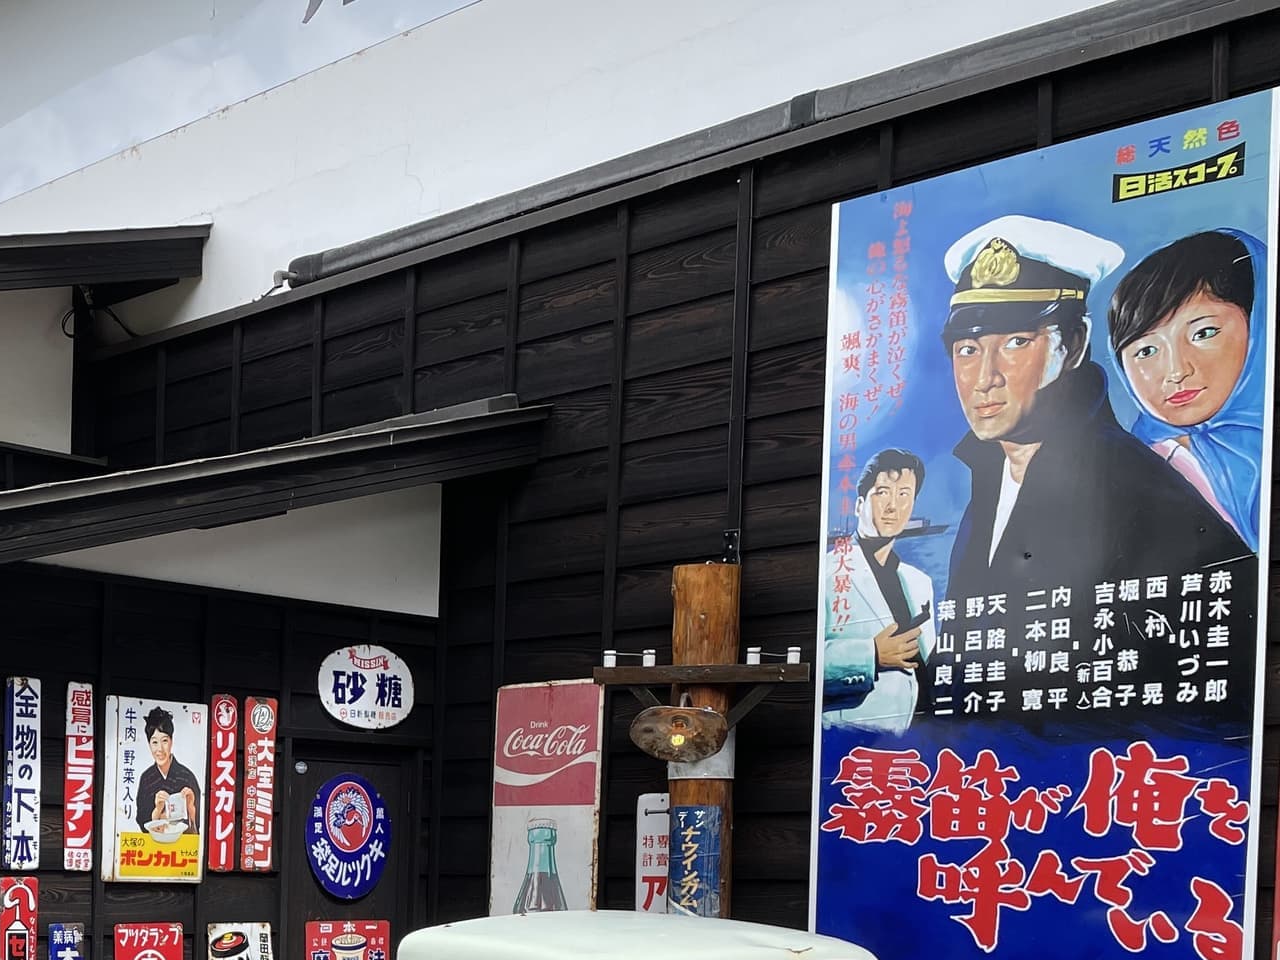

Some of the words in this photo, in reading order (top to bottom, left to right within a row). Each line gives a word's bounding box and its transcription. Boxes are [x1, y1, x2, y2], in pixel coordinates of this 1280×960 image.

[332, 670, 402, 708] 砂糖
[934, 600, 956, 716] 葉山良二
[963, 597, 985, 713] 野呂圭介
[986, 593, 1008, 712] 天路圭子
[1022, 590, 1047, 711] 二本柳寛
[1047, 586, 1071, 705] 内田良平
[1092, 582, 1115, 709] 吉永小百合
[1115, 580, 1139, 706] 堀恭子
[1142, 576, 1168, 706] 西村晃
[1176, 573, 1203, 703] 芦川いづみ
[1204, 570, 1233, 703] 赤木圭一郎
[124, 707, 137, 743] 牛肉
[530, 720, 549, 729] Drink
[122, 750, 136, 820] 野菜入り
[215, 731, 235, 866] リスカレー
[120, 849, 198, 867] ボンカレー
